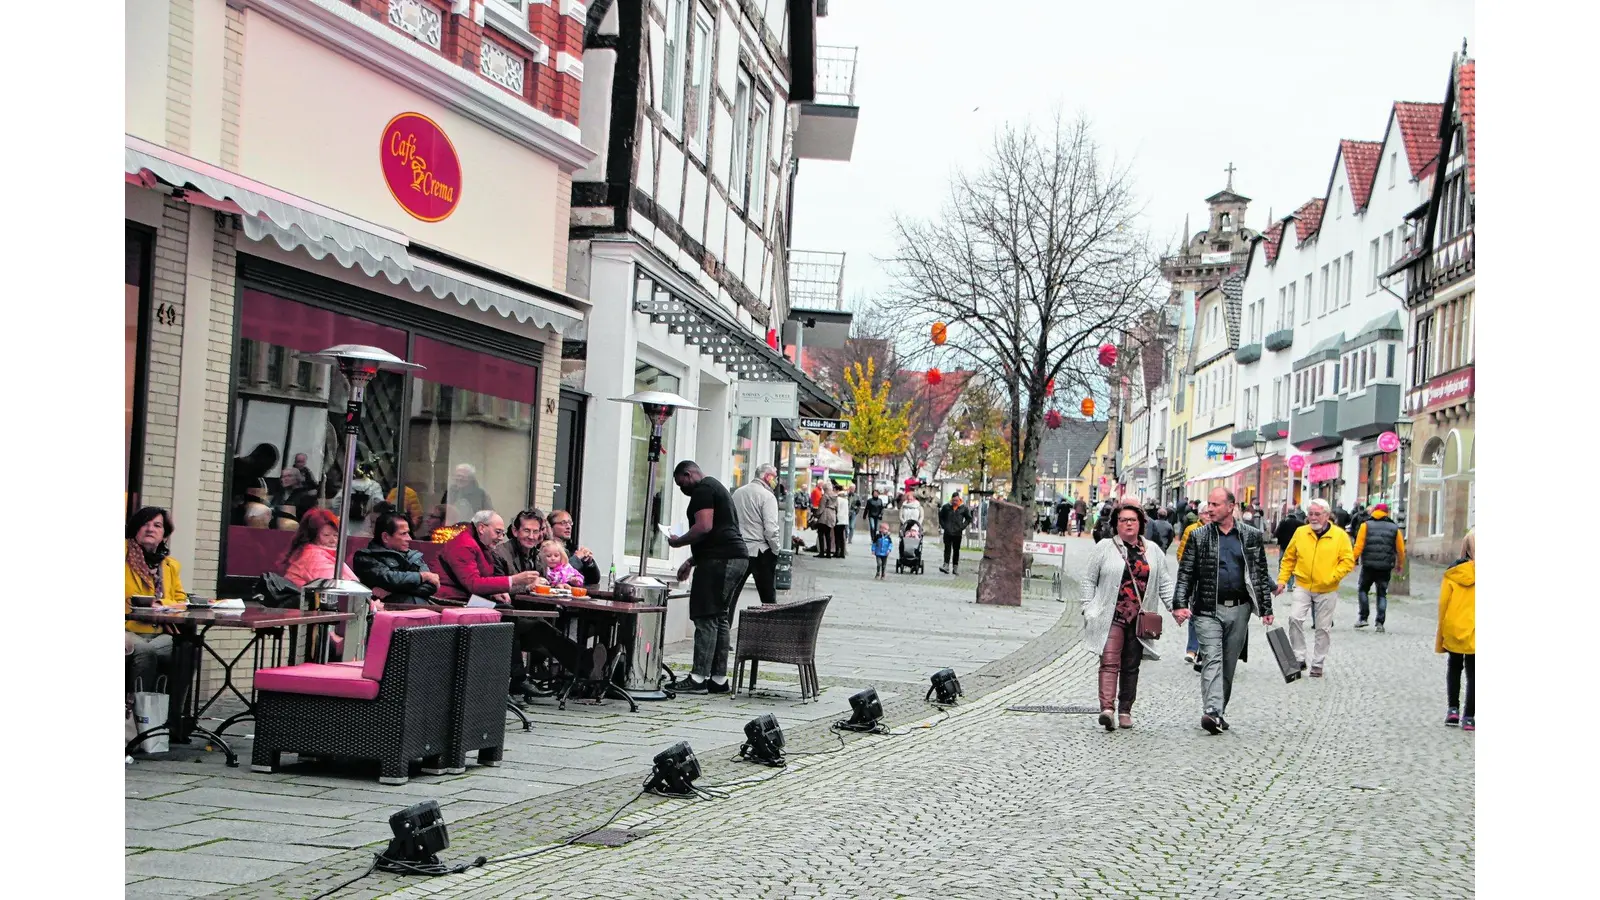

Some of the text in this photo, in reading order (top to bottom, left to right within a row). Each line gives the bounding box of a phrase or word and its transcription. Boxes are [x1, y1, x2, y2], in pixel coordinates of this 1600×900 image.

[391, 131, 417, 165] Café
[423, 172, 454, 202] Crema
[157, 303, 176, 326] 49
